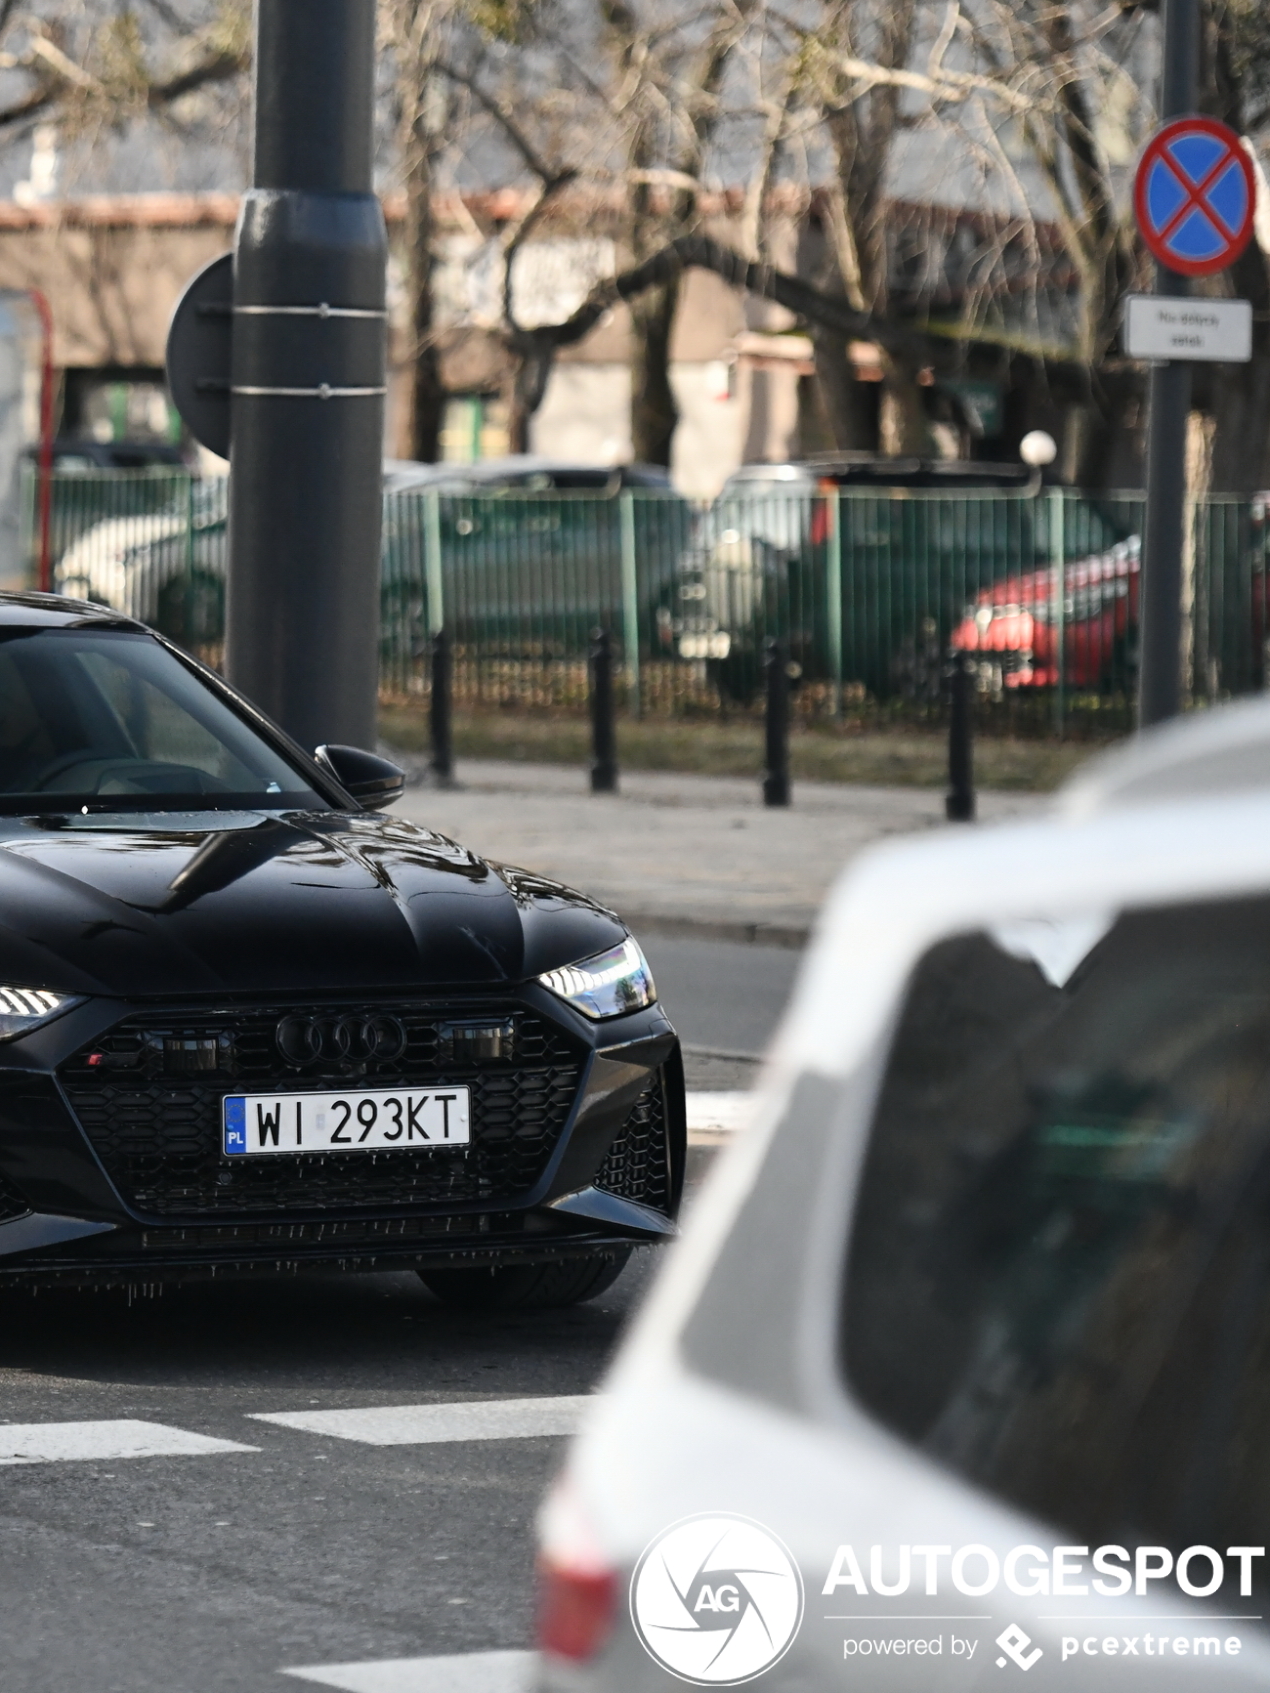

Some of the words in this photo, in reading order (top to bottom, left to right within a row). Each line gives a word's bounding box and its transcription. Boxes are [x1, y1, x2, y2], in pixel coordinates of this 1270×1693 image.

[257, 1101, 302, 1146] WI
[330, 1094, 457, 1143] 293KT
[228, 1132, 243, 1144] PL
